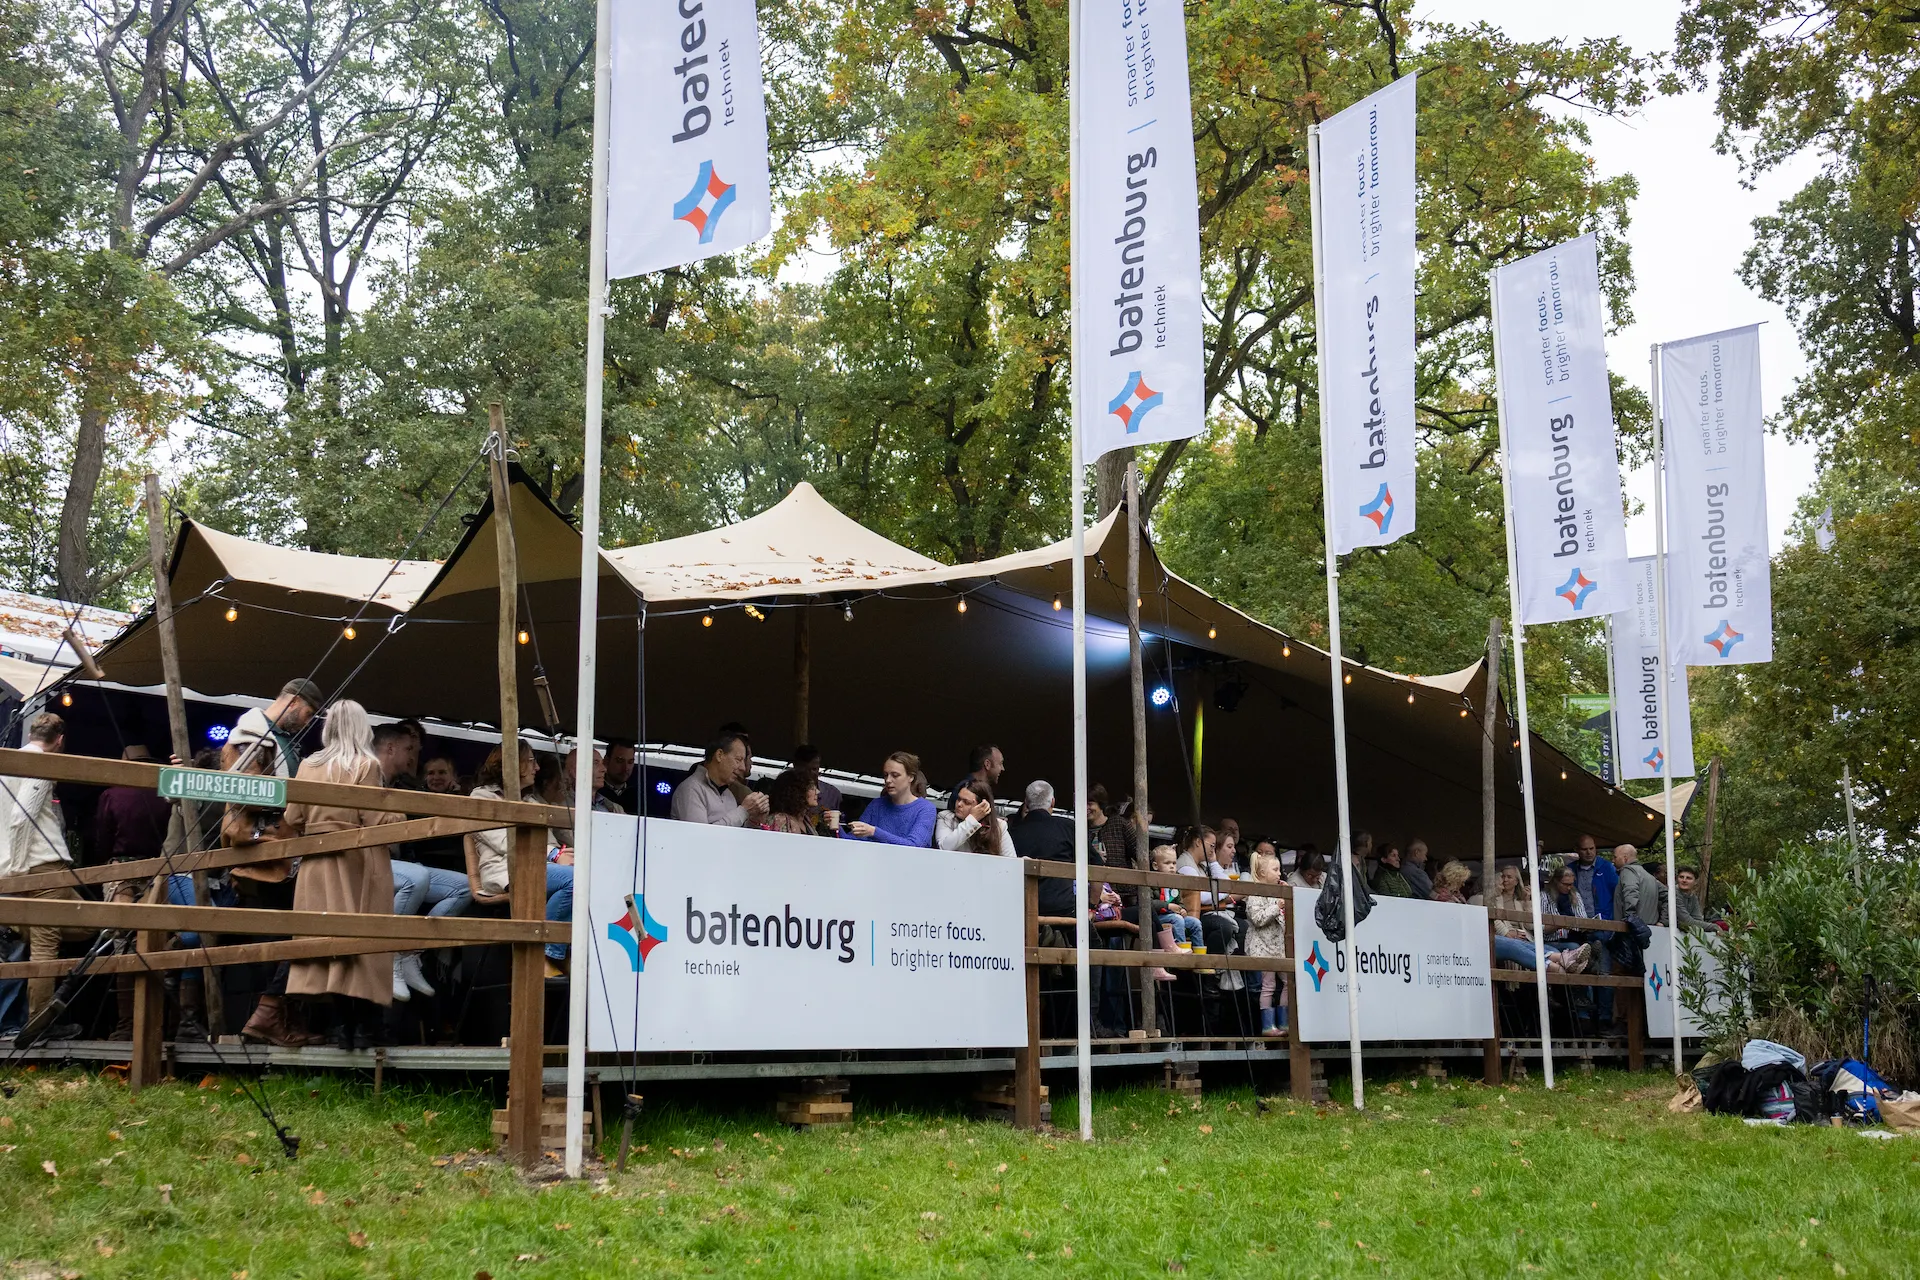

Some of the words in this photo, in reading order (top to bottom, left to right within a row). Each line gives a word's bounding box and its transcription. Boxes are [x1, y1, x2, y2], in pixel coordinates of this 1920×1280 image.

[718, 38, 735, 127] techniek
[1124, 35, 1138, 107] smarter
[1141, 22, 1155, 100] brighter
[1369, 104, 1379, 189] tomorrow.
[1357, 149, 1365, 198] focus.
[1370, 195, 1382, 256] brighter
[1110, 146, 1157, 357] batenburg
[1537, 291, 1549, 333] focus.
[1549, 256, 1564, 326] tomorrow.
[1153, 284, 1166, 349] techniek
[1541, 337, 1554, 386] smarter
[1556, 330, 1570, 382] brighter
[1711, 340, 1723, 403] tomorrow.
[1699, 370, 1709, 407] focus.
[1700, 411, 1712, 456] smarter
[1714, 408, 1728, 453] brighter
[1548, 413, 1580, 558] batenburg
[1583, 508, 1595, 552] techniek
[1702, 482, 1729, 609] batenburg
[1734, 568, 1744, 607] techniek
[1639, 656, 1659, 740] batenburg
[186, 773, 276, 798] HORSEFRIEND
[686, 896, 856, 964] batenburg
[891, 921, 942, 939] smarter
[947, 921, 986, 942] focus.
[684, 959, 740, 976] techniek
[891, 948, 944, 972] brighter
[948, 951, 1015, 971] tomorrow.
[1336, 941, 1412, 984] btenburg
[1426, 953, 1451, 966] smarter
[1452, 953, 1472, 967] focus.
[1427, 972, 1453, 988] brighter
[1454, 974, 1487, 987] tomorrow.
[1336, 982, 1362, 993] techk
